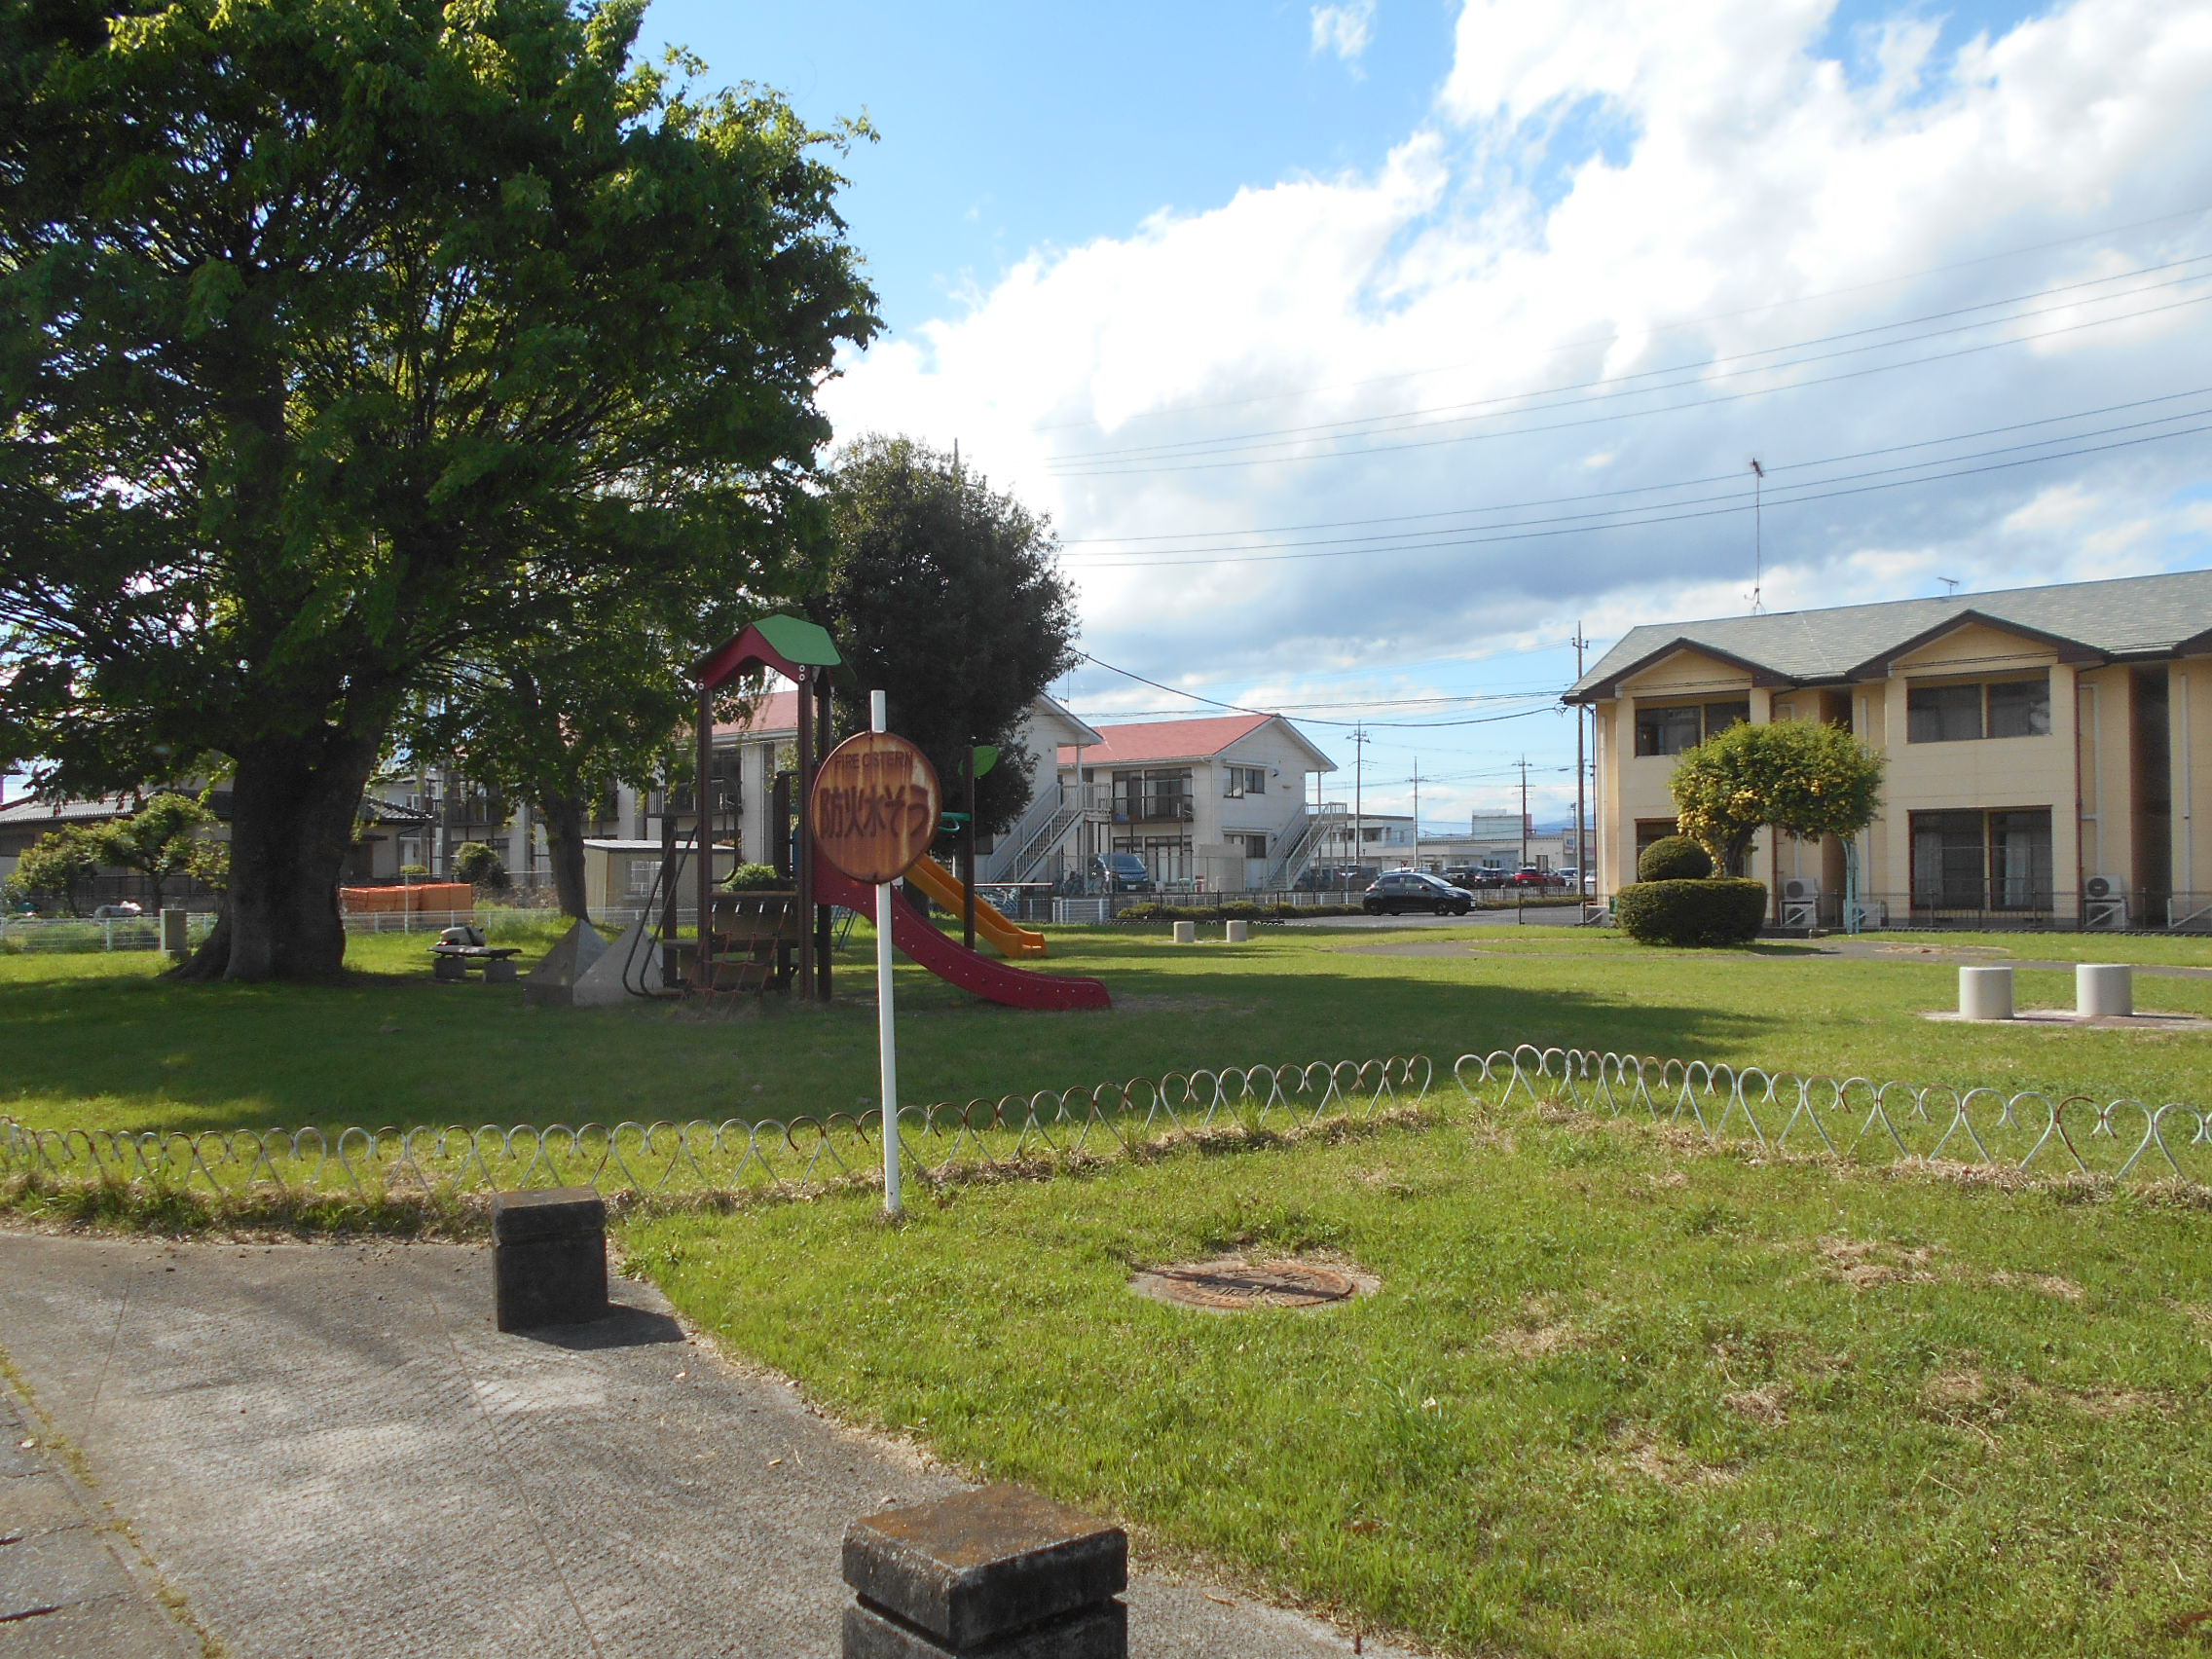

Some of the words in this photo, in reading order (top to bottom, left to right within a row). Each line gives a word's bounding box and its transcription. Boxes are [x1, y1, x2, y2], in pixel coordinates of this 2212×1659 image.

[835, 753, 859, 769] FIRE
[820, 784, 929, 839] 防火水そう
